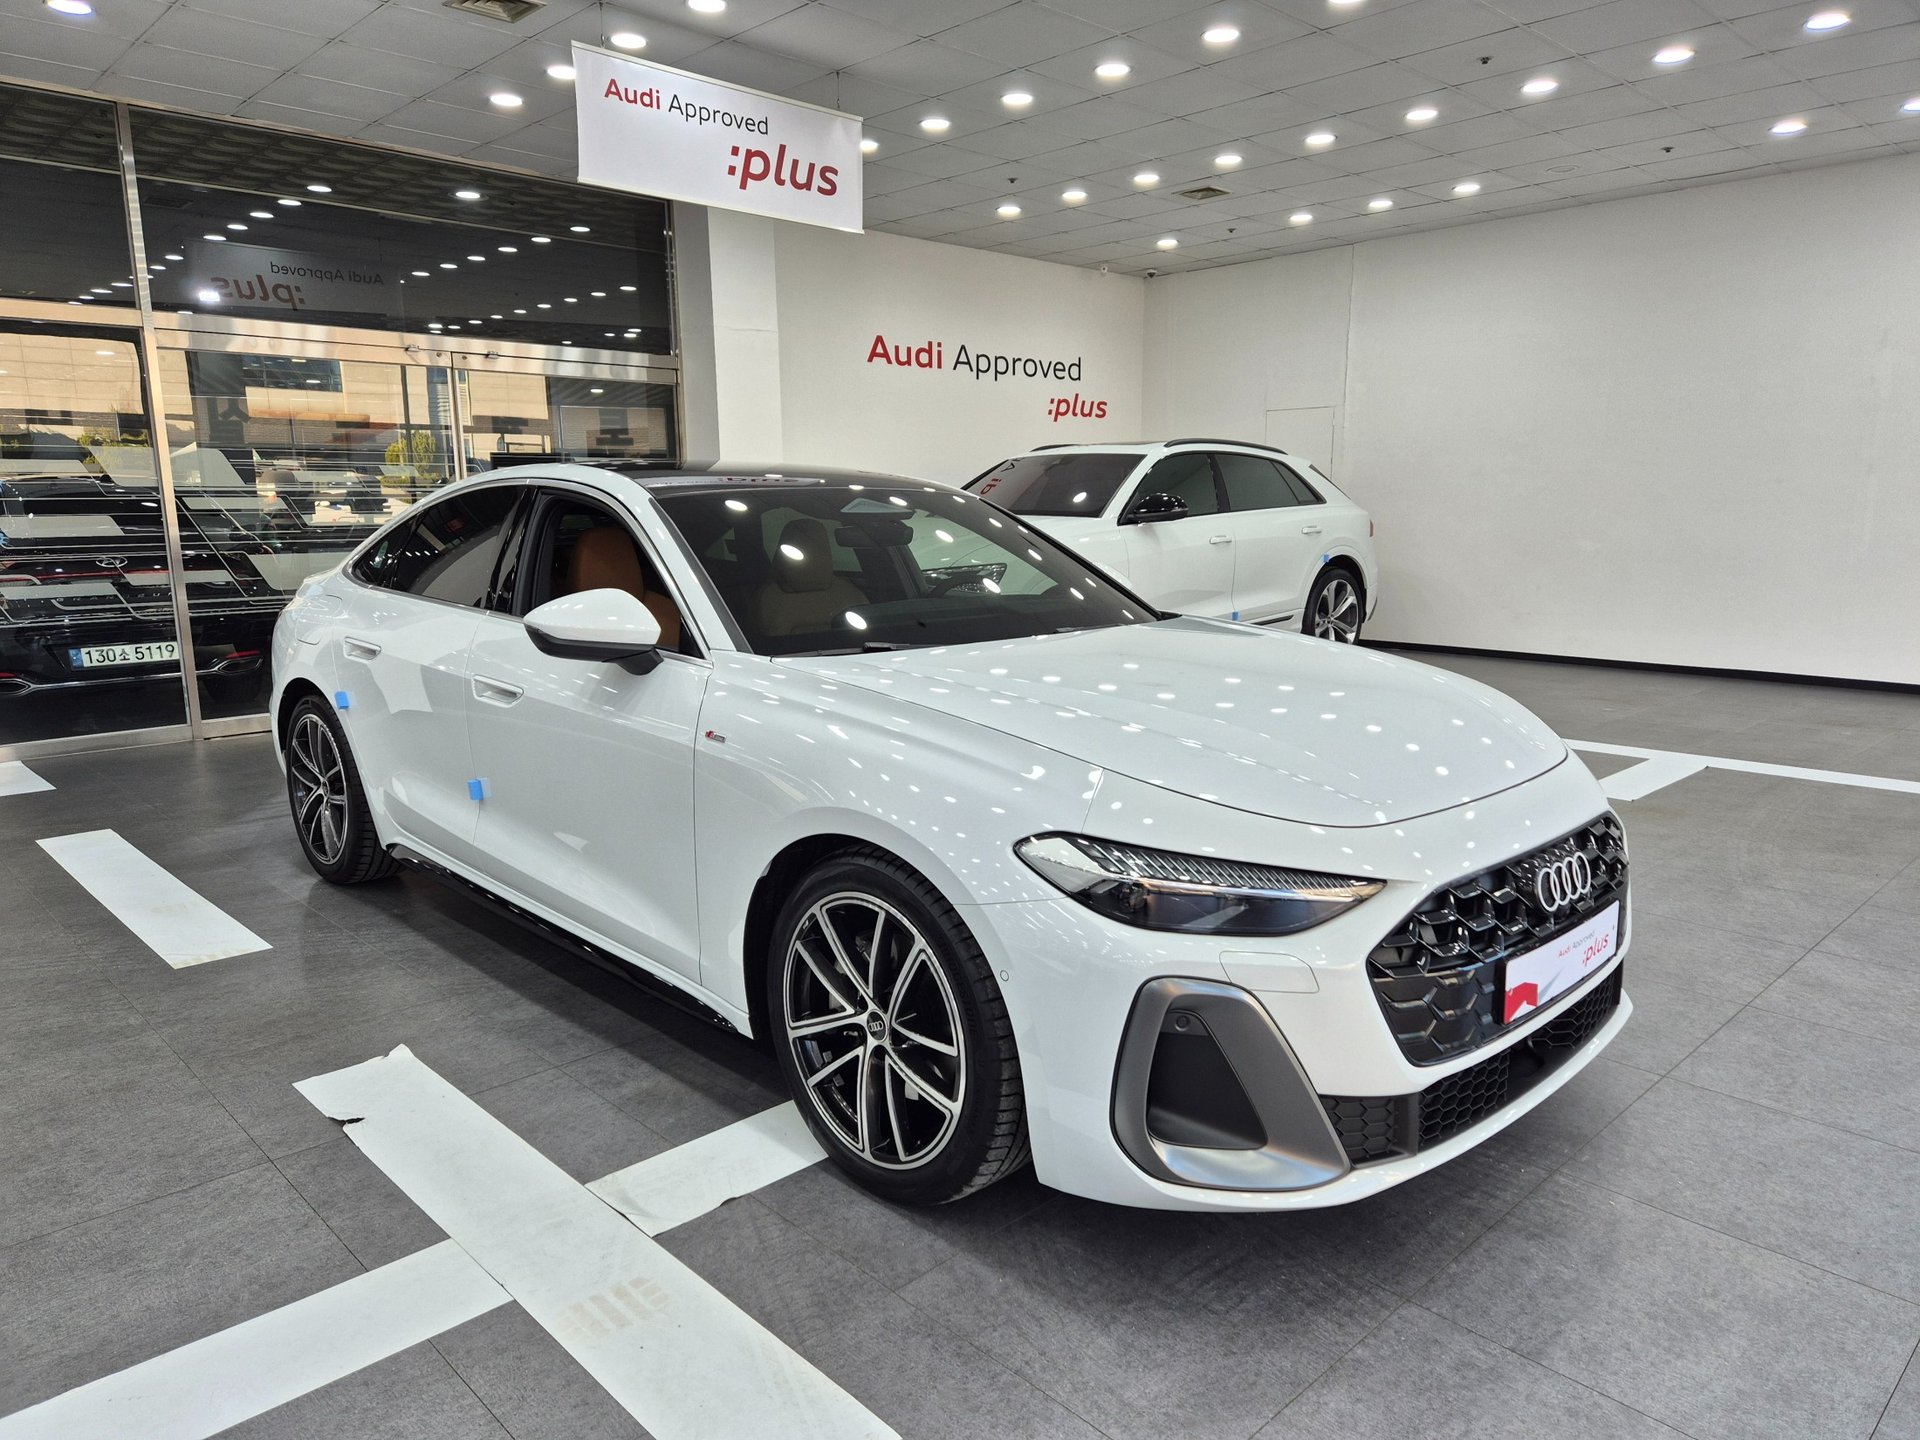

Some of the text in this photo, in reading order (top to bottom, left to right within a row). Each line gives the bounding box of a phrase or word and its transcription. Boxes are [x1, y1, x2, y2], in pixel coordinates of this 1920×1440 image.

[604, 78, 769, 136] Audi Approved
[727, 143, 839, 196] :plus
[866, 334, 1082, 381] Audi Approved
[1047, 393, 1108, 422] :plus
[85, 643, 175, 665] 130소 5119
